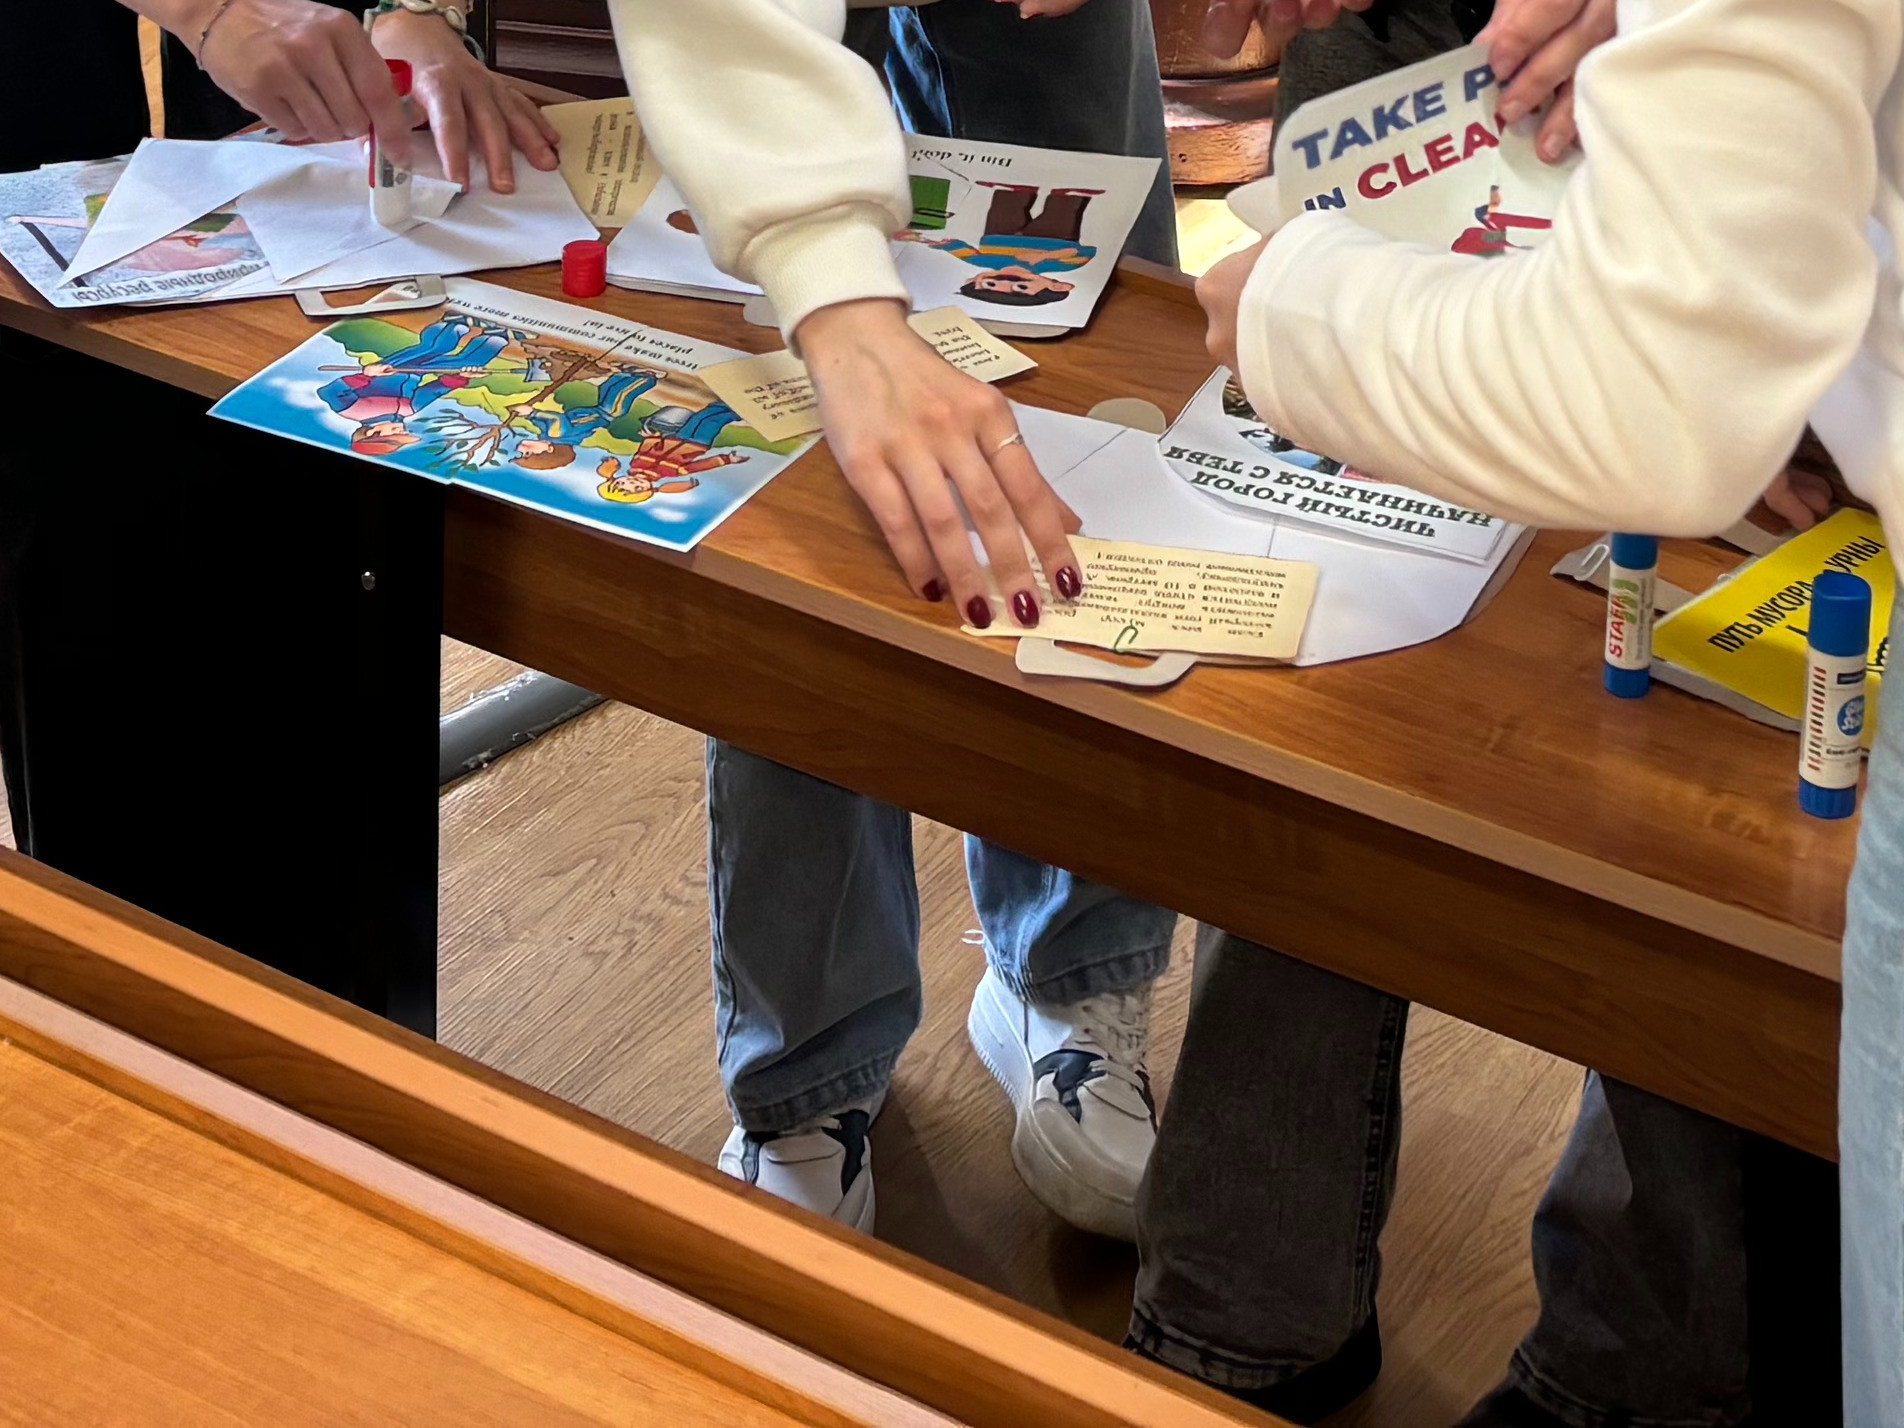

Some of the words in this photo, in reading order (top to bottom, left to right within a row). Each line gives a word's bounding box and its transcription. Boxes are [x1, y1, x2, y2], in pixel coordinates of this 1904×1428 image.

[1292, 82, 1447, 169] TAKE
[1304, 187, 1347, 211] IN
[1163, 445, 1246, 476] ТЕБЯ
[1249, 465, 1270, 479] С
[1191, 470, 1295, 506] ГОРОД
[1278, 470, 1493, 528] НАЧИНАЕТСЯ
[1296, 495, 1436, 537] ЧИСТЫЙ
[1707, 621, 1764, 654] ПУТЬ
[1746, 580, 1815, 629] МУСОРА
[1824, 535, 1887, 574] УРНЫ
